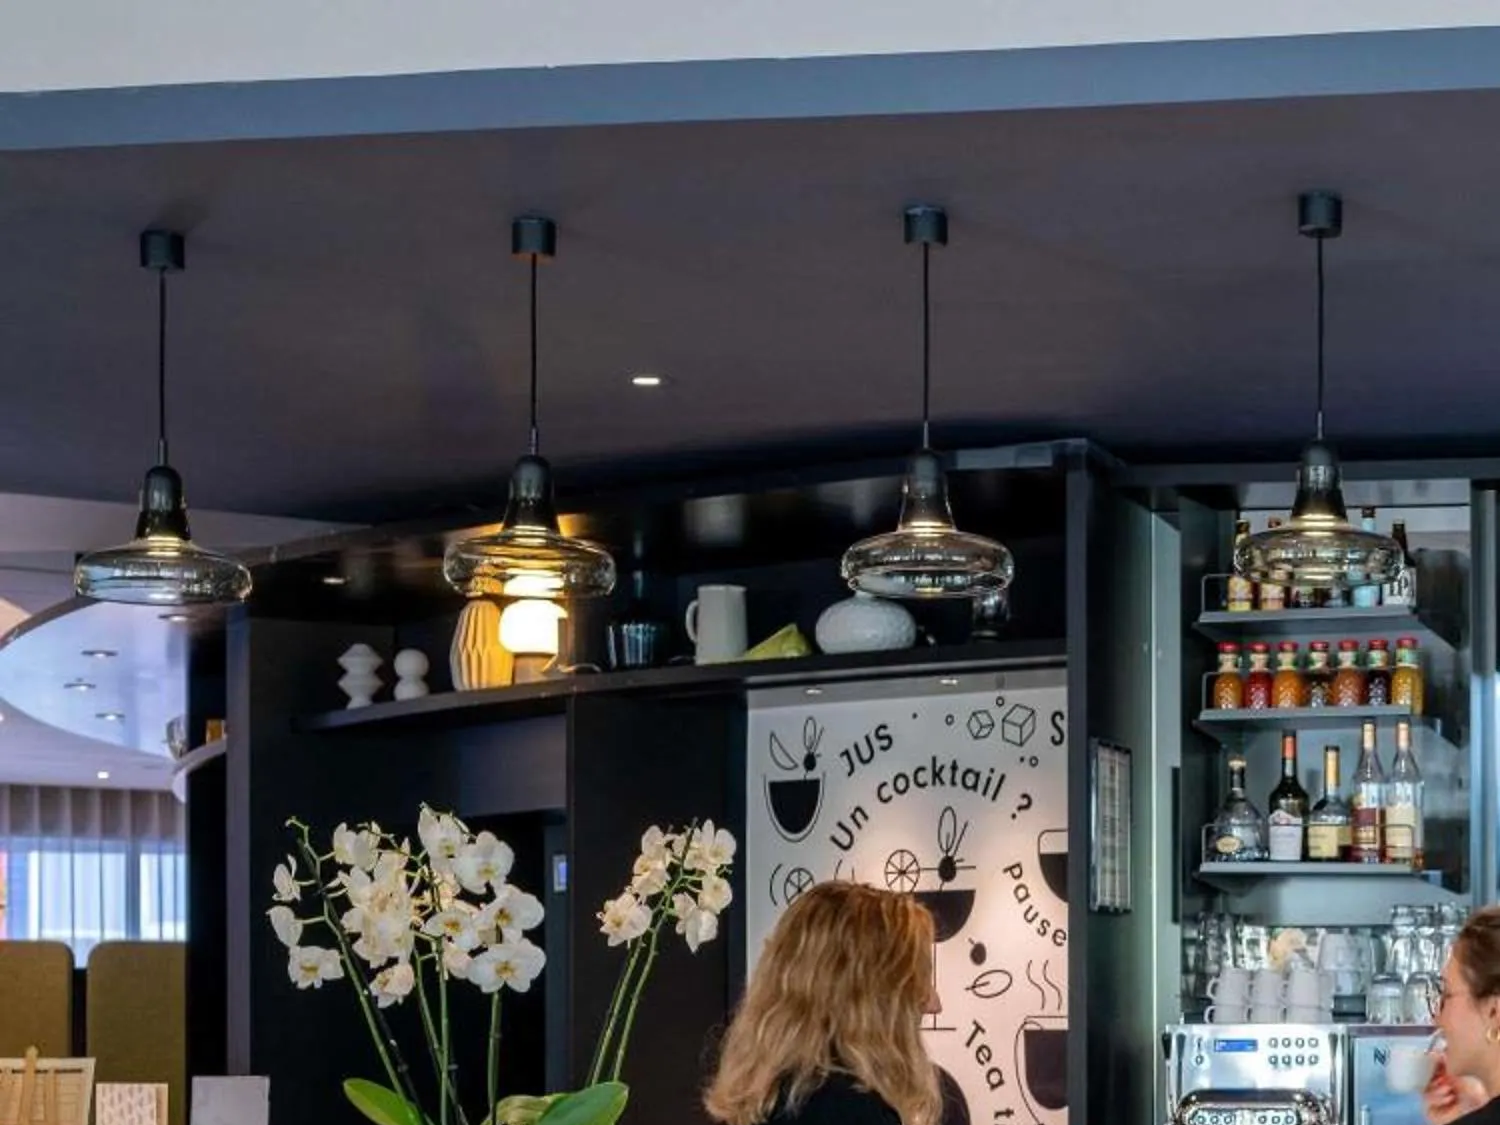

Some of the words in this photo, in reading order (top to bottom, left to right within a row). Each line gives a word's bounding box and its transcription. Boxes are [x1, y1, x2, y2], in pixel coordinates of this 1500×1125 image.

[839, 723, 895, 778] JUS
[829, 804, 870, 852] Un
[876, 755, 1007, 805] cocktail
[1009, 793, 1034, 821] ?
[1002, 861, 1068, 948] Pause
[964, 1018, 1006, 1093] Tea
